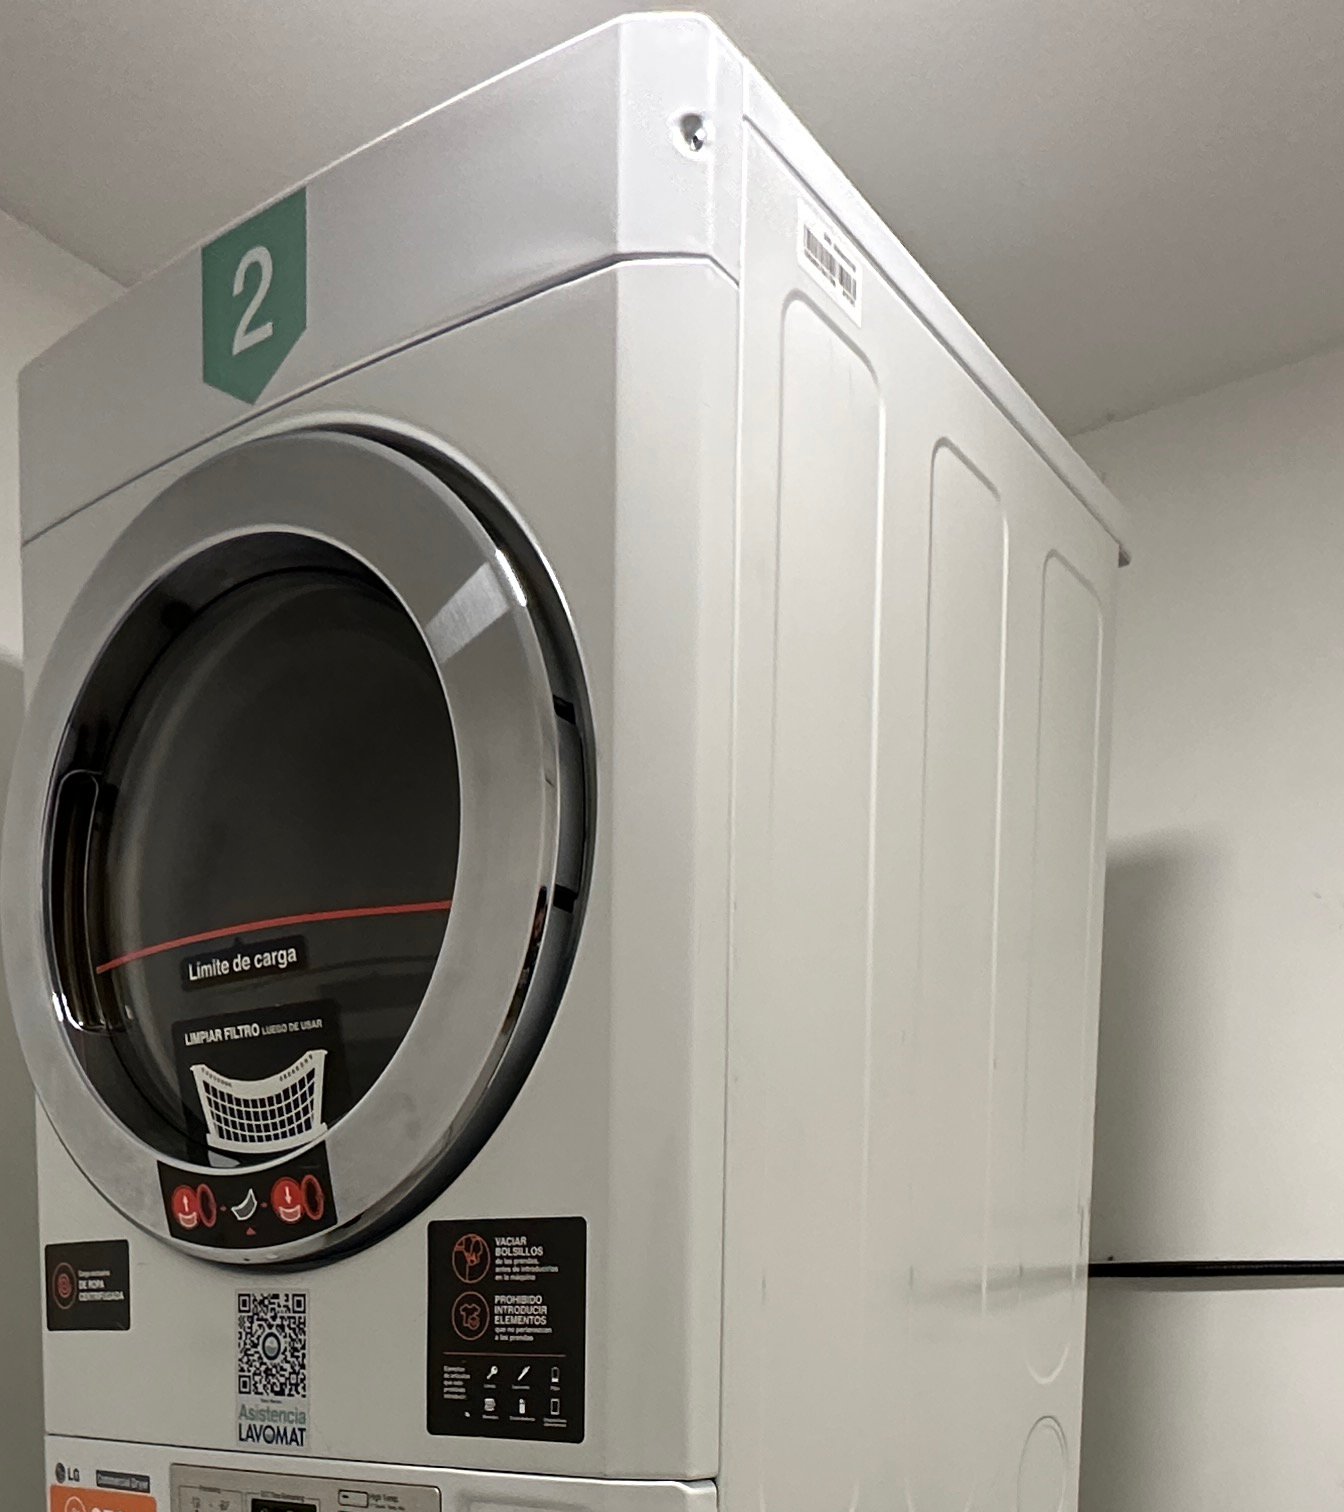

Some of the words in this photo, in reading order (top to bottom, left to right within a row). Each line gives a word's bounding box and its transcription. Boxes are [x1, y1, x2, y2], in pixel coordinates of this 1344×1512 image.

[232, 245, 273, 356] 2
[232, 953, 251, 972] de
[254, 948, 297, 969] carga
[185, 1028, 223, 1046] LIMPIAR
[224, 1022, 260, 1041] FILTRO
[288, 1022, 299, 1032] DE
[300, 1018, 323, 1031] USAR
[494, 1236, 527, 1246] VACIAR
[495, 1246, 543, 1256] BOLSILLOS
[494, 1295, 542, 1304] PROHIBIDO
[494, 1305, 547, 1315] INTRODUCIR
[494, 1315, 547, 1325] ELEMENTOS
[239, 1404, 306, 1424] Asistencia
[239, 1423, 306, 1447] LAVOMAT
[68, 1467, 80, 1482] LG
